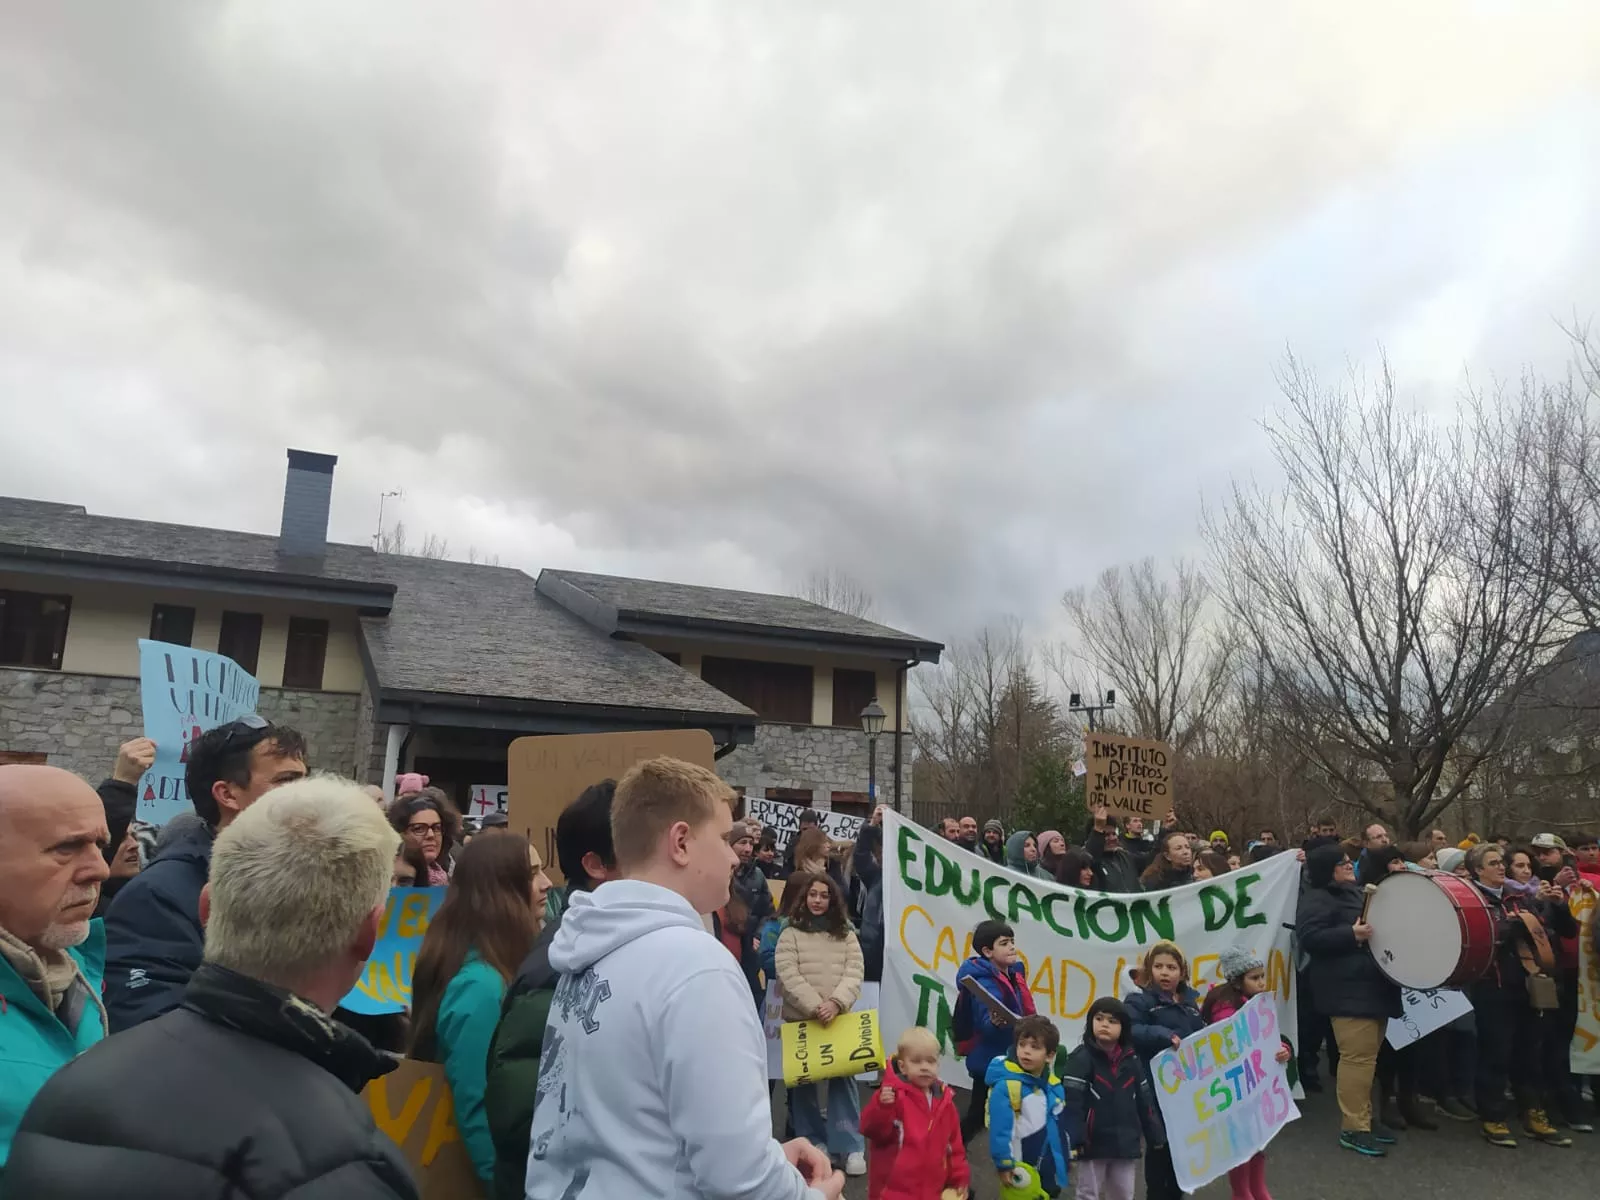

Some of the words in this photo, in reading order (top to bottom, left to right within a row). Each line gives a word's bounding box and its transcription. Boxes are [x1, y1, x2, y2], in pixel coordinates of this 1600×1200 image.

[1093, 740, 1167, 766] INSTITUTO
[1094, 773, 1167, 796] INSTITUTO
[750, 800, 829, 824] EDUCACN
[1112, 796, 1153, 814] VALLE
[1199, 872, 1268, 932] DE
[820, 1043, 834, 1066] UN
[1158, 996, 1275, 1095] QUEREMOS
[1193, 1049, 1267, 1124] ESTAR
[1185, 1076, 1289, 1177] JUNTOS
